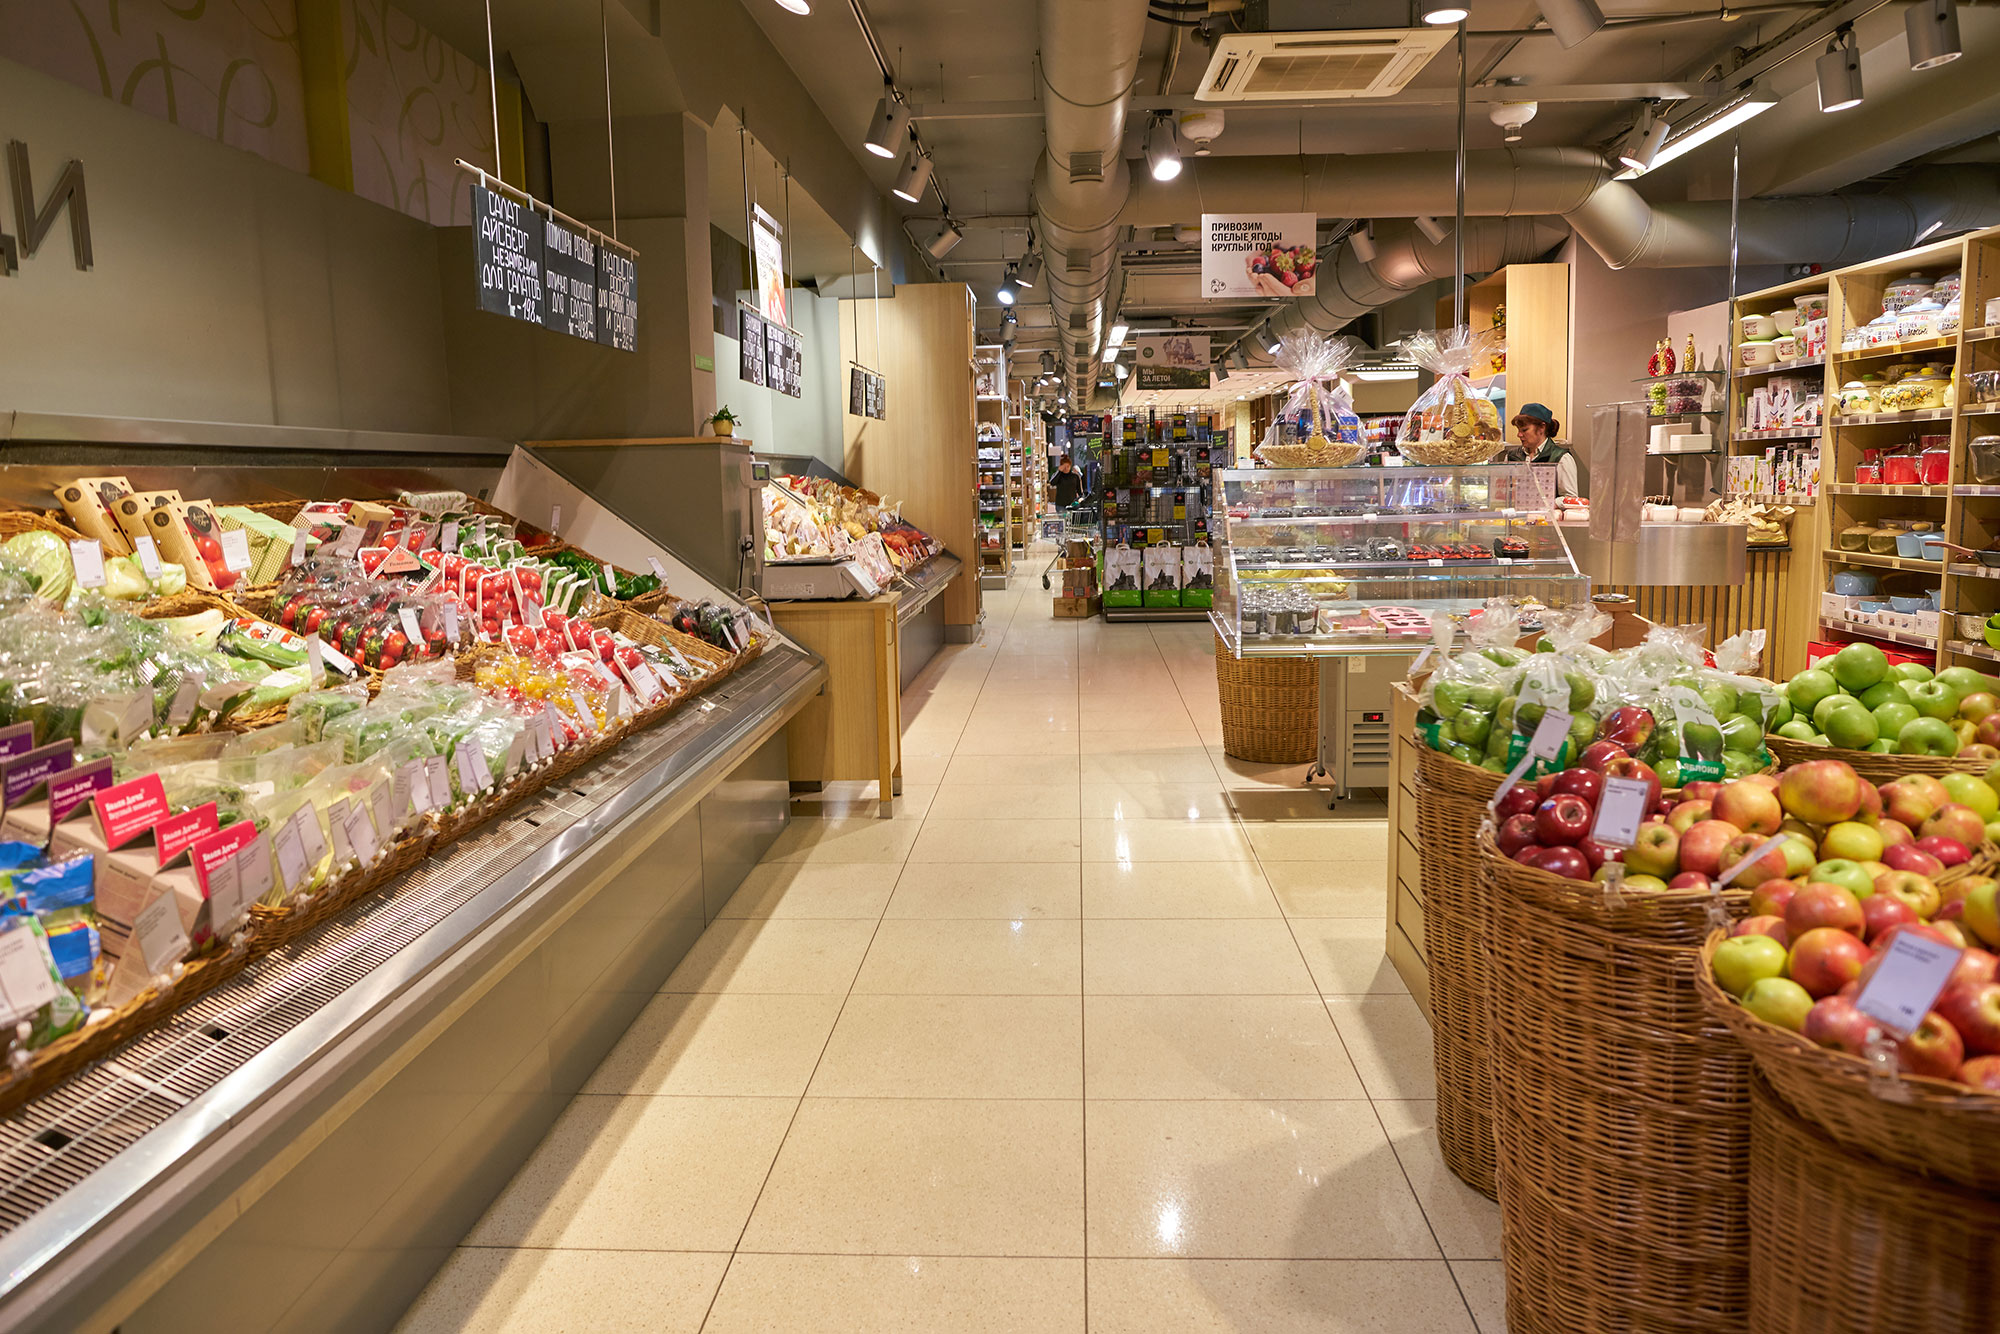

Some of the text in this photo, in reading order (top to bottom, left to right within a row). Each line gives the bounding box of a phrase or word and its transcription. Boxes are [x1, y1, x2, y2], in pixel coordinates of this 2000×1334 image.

[488, 191, 520, 226] САЛАТ
[482, 216, 529, 255] АЙСБЕРГ
[1211, 222, 1262, 231] ПРИВОЗИМ
[1211, 232, 1282, 242] СПЕЛЫЕ ЯГОДЫ
[492, 245, 538, 278] НЕЗАМЕНИМ
[1211, 241, 1272, 252] КРУГЛЫЙ ГОД
[483, 263, 541, 301] ДЛЯ САЛАТОВ
[602, 249, 634, 284] КАПУСТА
[552, 291, 593, 325] ДЛЯ САЛАТОВ
[605, 310, 634, 338] И САЛАТОВ
[1683, 762, 1720, 775] ЯБЛОКИ
